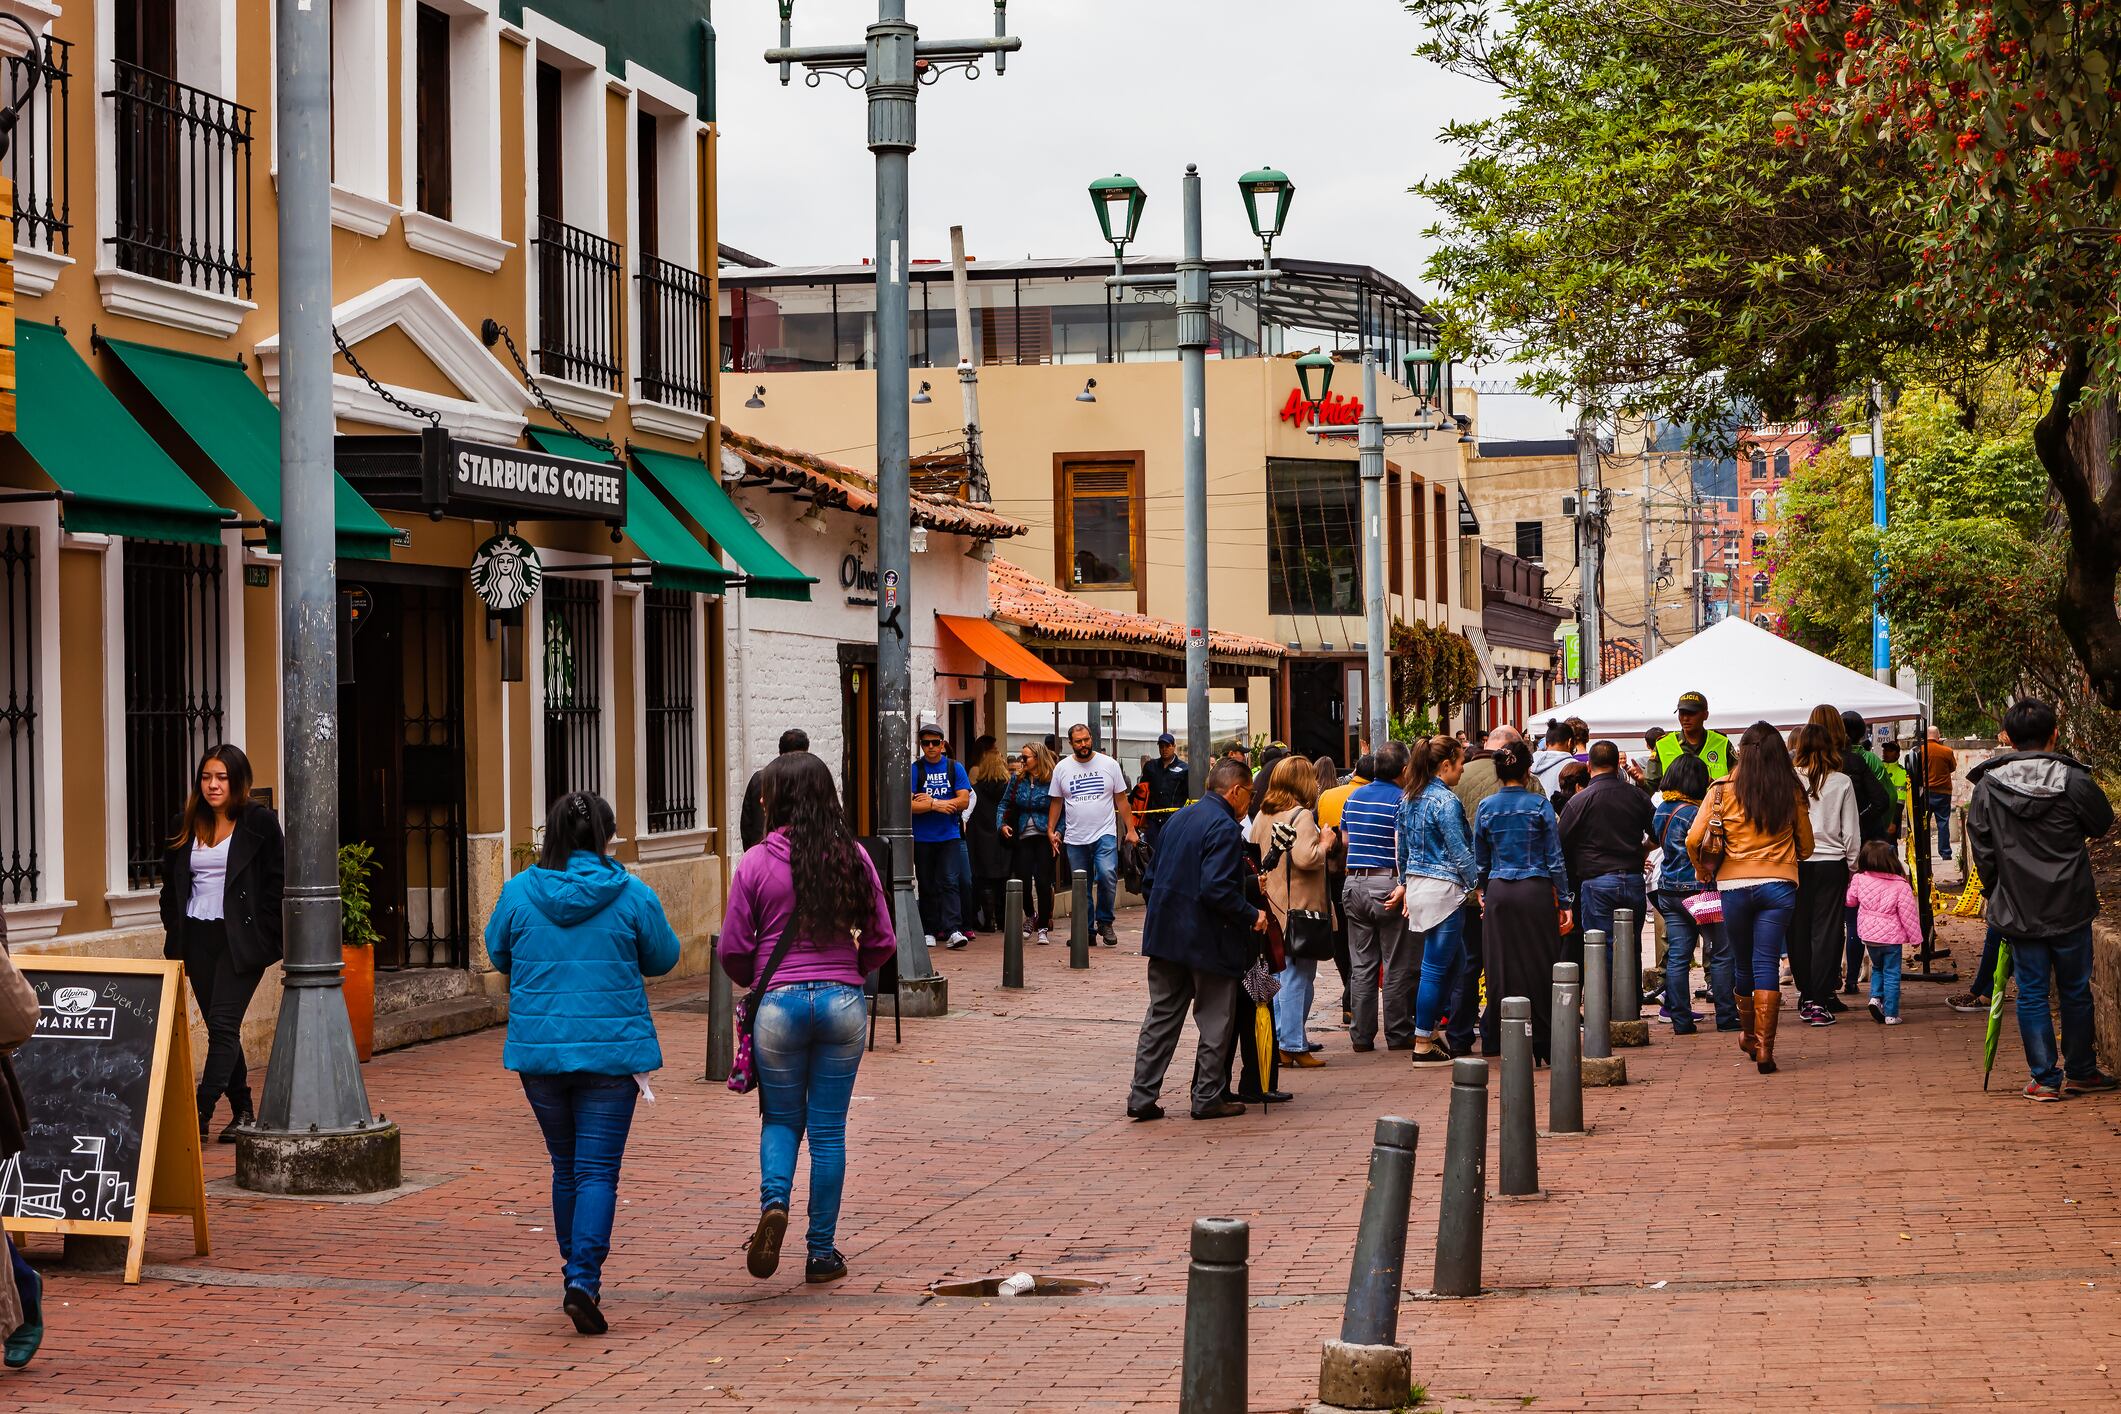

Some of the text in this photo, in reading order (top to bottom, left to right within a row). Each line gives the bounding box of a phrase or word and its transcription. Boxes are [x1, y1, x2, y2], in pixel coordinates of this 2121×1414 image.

[458, 451, 620, 505] STARBUCKS COFFEE
[926, 772, 948, 782] MEET
[925, 787, 948, 797] BAR
[60, 988, 89, 1001] Alpina
[35, 1016, 109, 1030] MARKET
